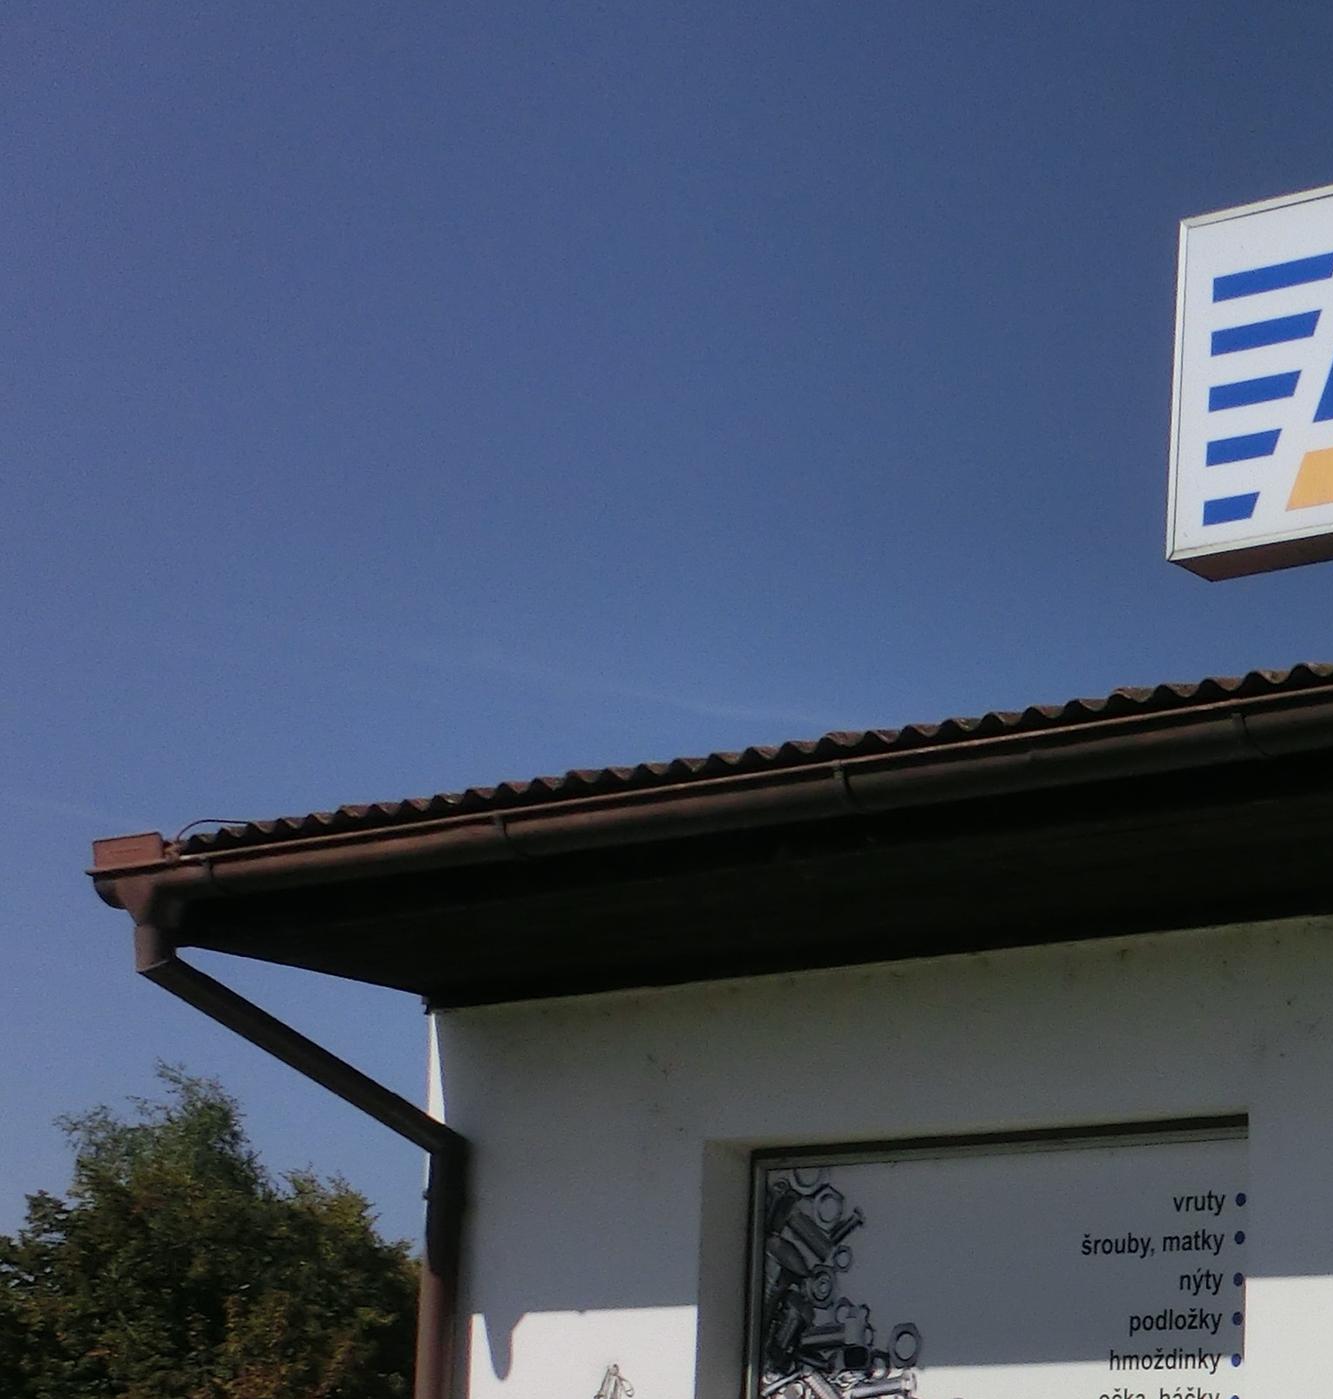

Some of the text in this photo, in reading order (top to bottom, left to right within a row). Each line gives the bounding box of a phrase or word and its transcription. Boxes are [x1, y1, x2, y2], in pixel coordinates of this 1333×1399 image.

[1173, 1190, 1225, 1215] vruty
[1081, 1229, 1224, 1258] šrouby, matky
[1179, 1268, 1223, 1296] nýty
[1129, 1308, 1222, 1336] podložky
[1109, 1349, 1221, 1375] hmoždinky
